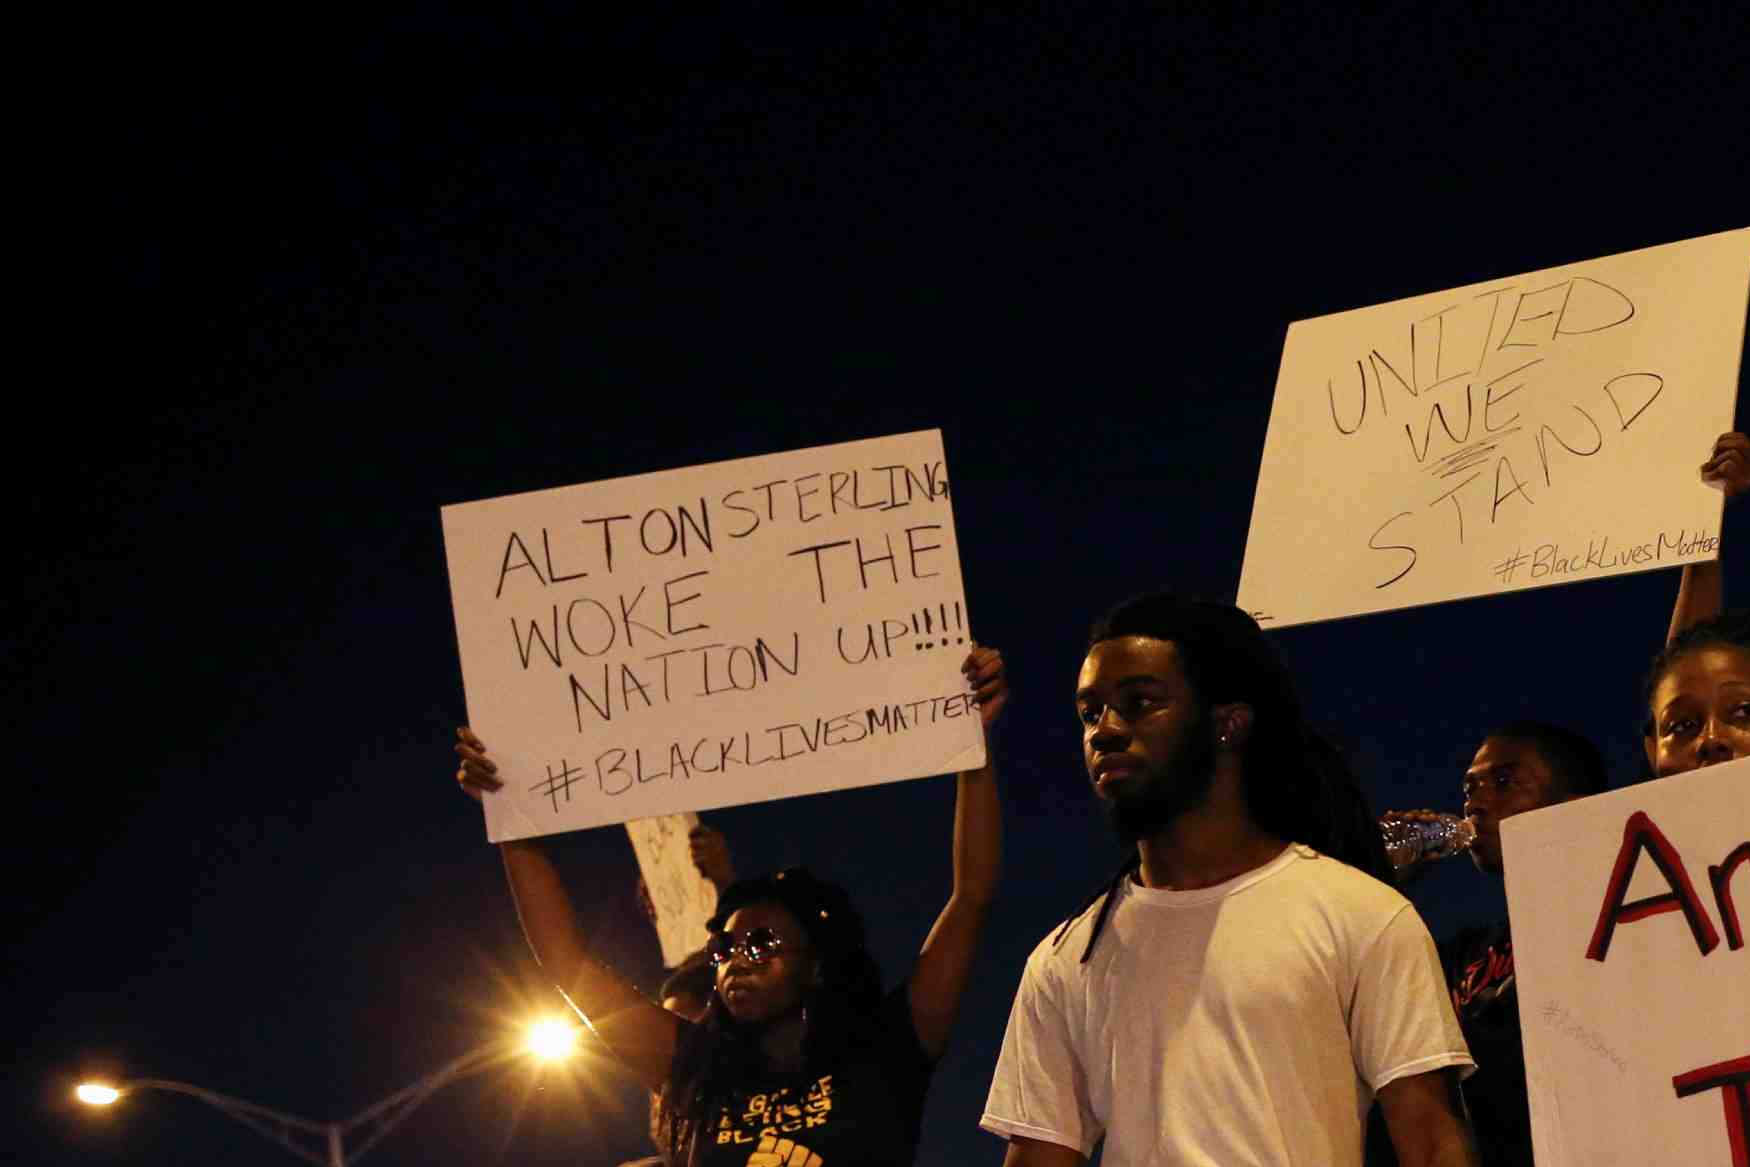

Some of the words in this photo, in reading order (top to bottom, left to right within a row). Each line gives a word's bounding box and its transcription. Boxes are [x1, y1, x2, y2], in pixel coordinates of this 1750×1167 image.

[1328, 276, 1635, 434] UNITED
[1406, 358, 1544, 462] WE
[495, 498, 713, 599] ALTON
[721, 461, 949, 538] STERLING
[1368, 372, 1664, 589] STAND
[510, 571, 710, 670] WOKE
[787, 525, 942, 603] THE
[569, 632, 799, 733] NATION
